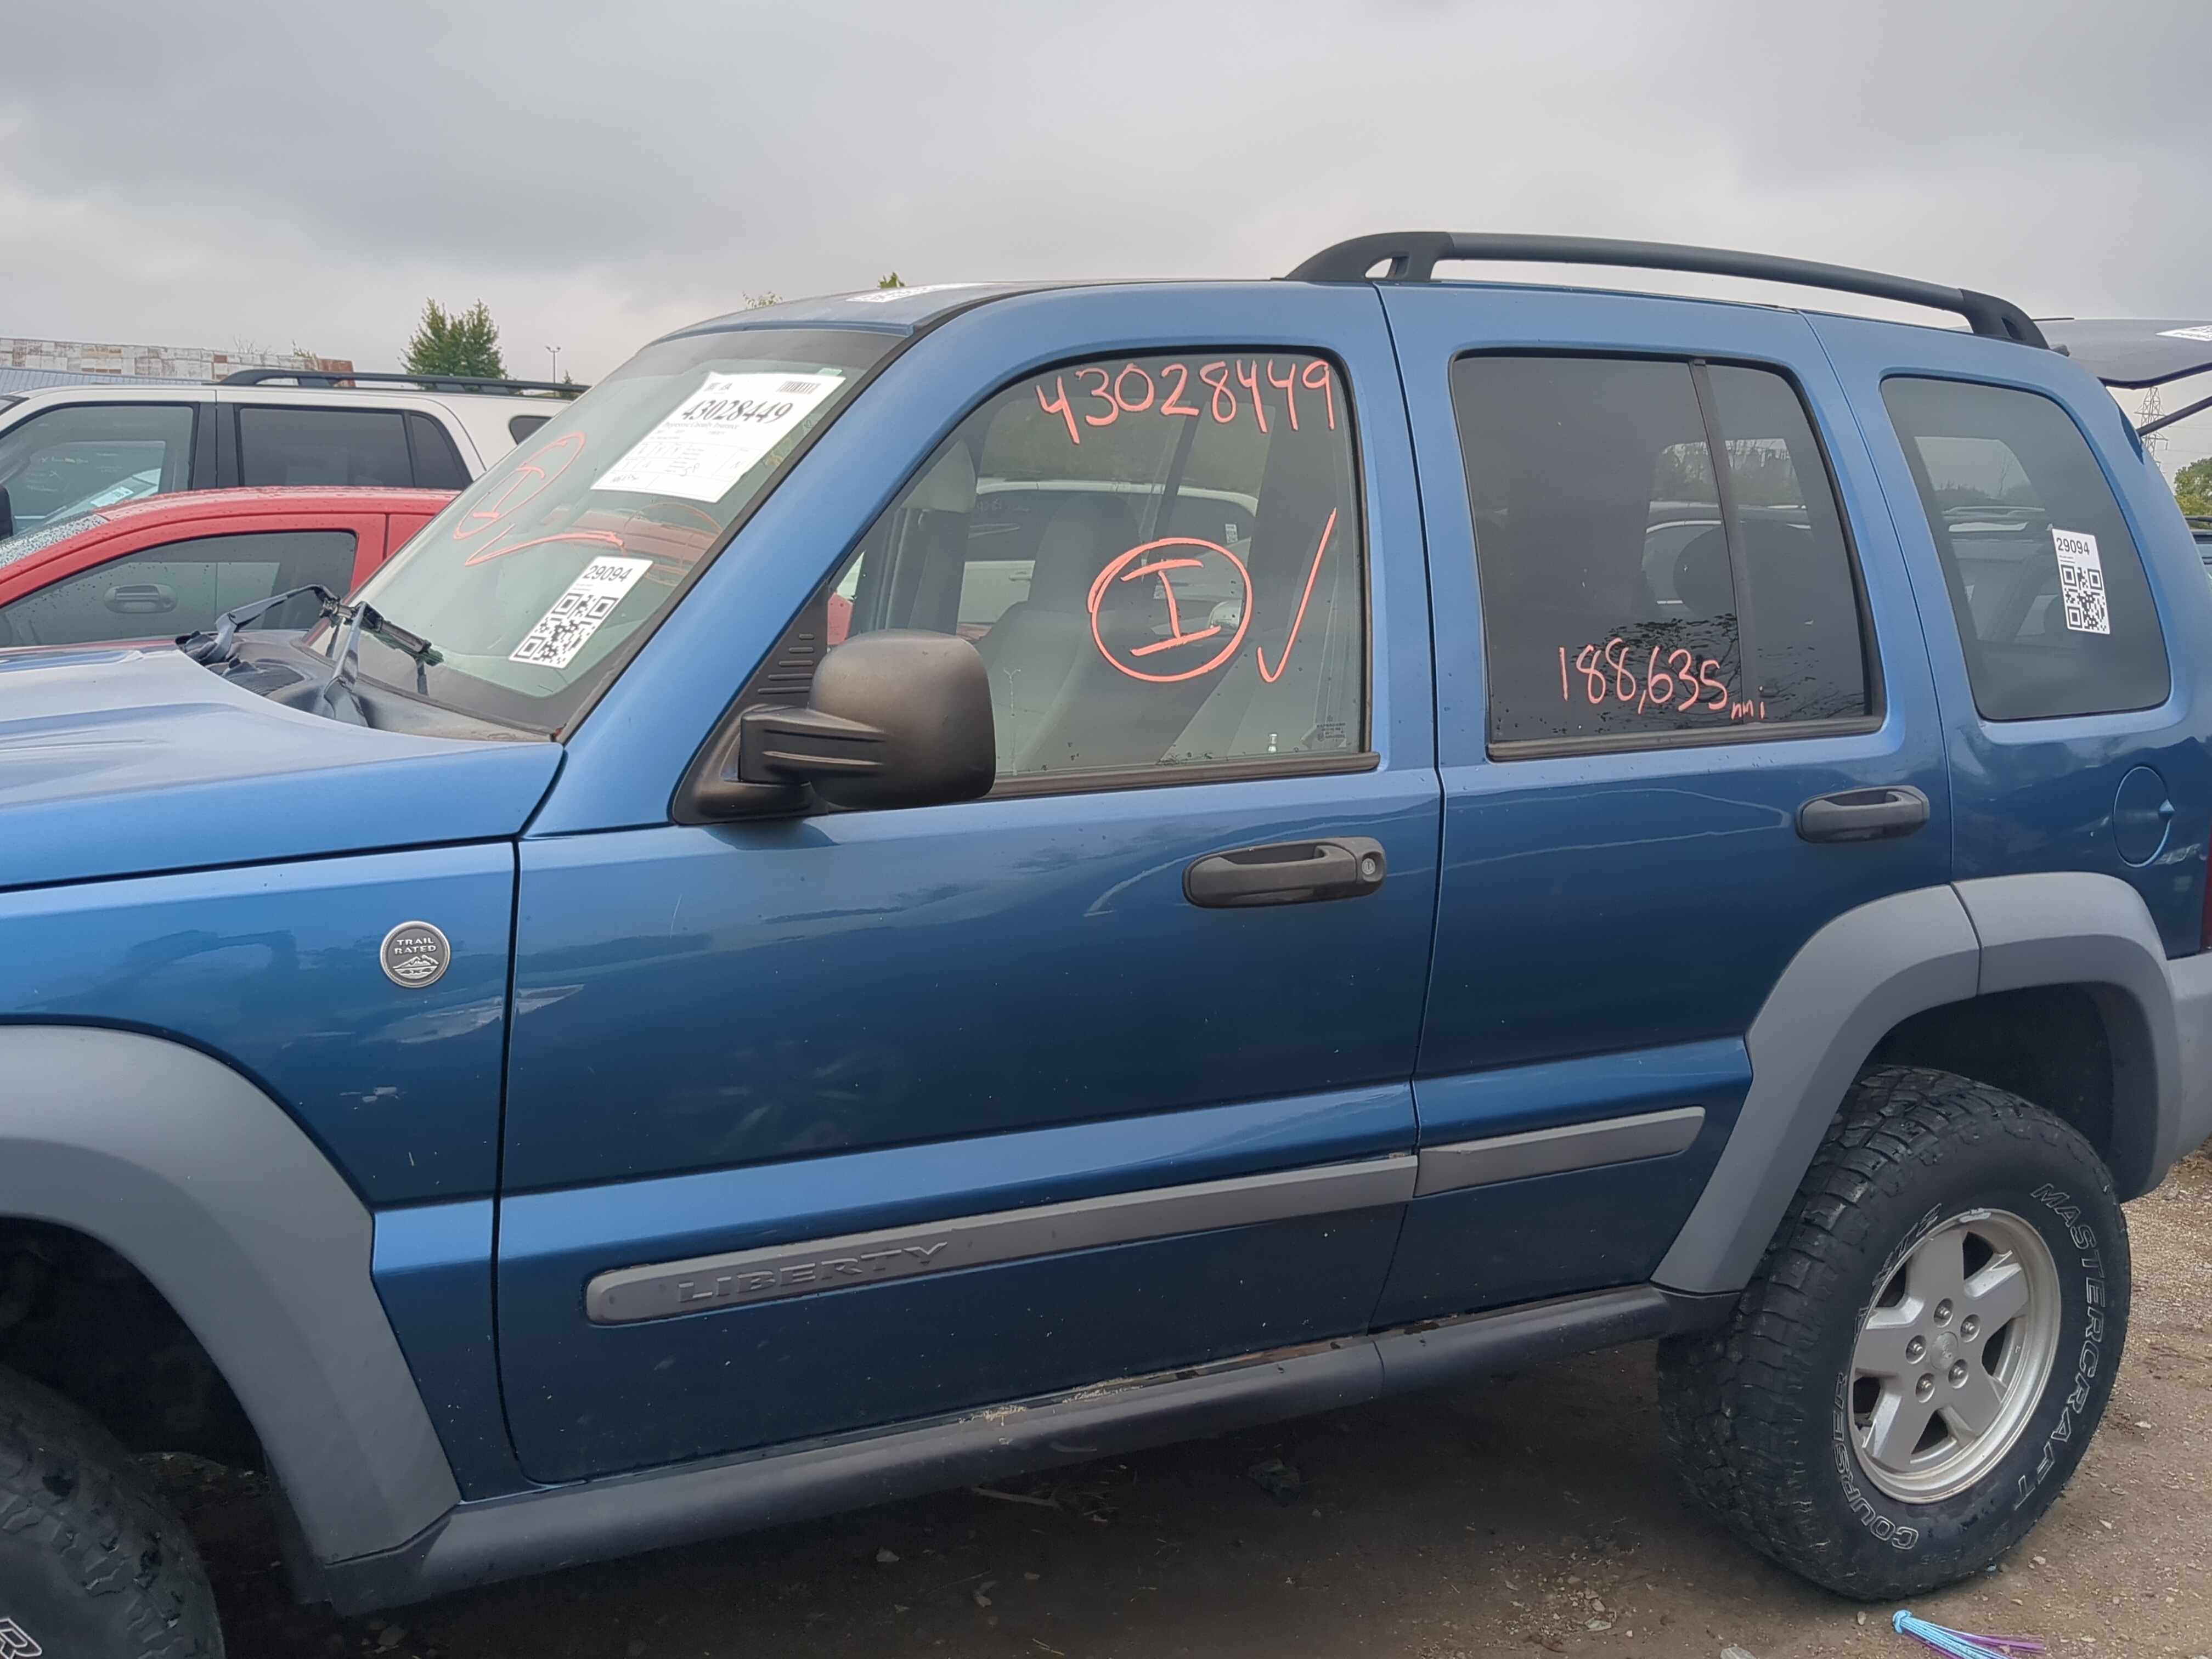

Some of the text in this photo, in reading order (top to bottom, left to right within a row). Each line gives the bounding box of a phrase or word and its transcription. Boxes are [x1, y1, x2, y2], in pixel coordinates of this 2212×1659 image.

[682, 400, 793, 424] 43028449
[1035, 358, 1335, 444] 43028449
[2056, 537, 2090, 555] 29094
[582, 565, 633, 582] 29094
[1559, 637, 1728, 714] 188,635
[394, 945, 437, 955] RATED
[396, 937, 434, 946] TRAIL
[679, 1241, 948, 1303] LIBERTY
[2014, 1182, 2106, 1511] MASTERCRAFT
[1831, 1371, 1919, 1550] COURSER
